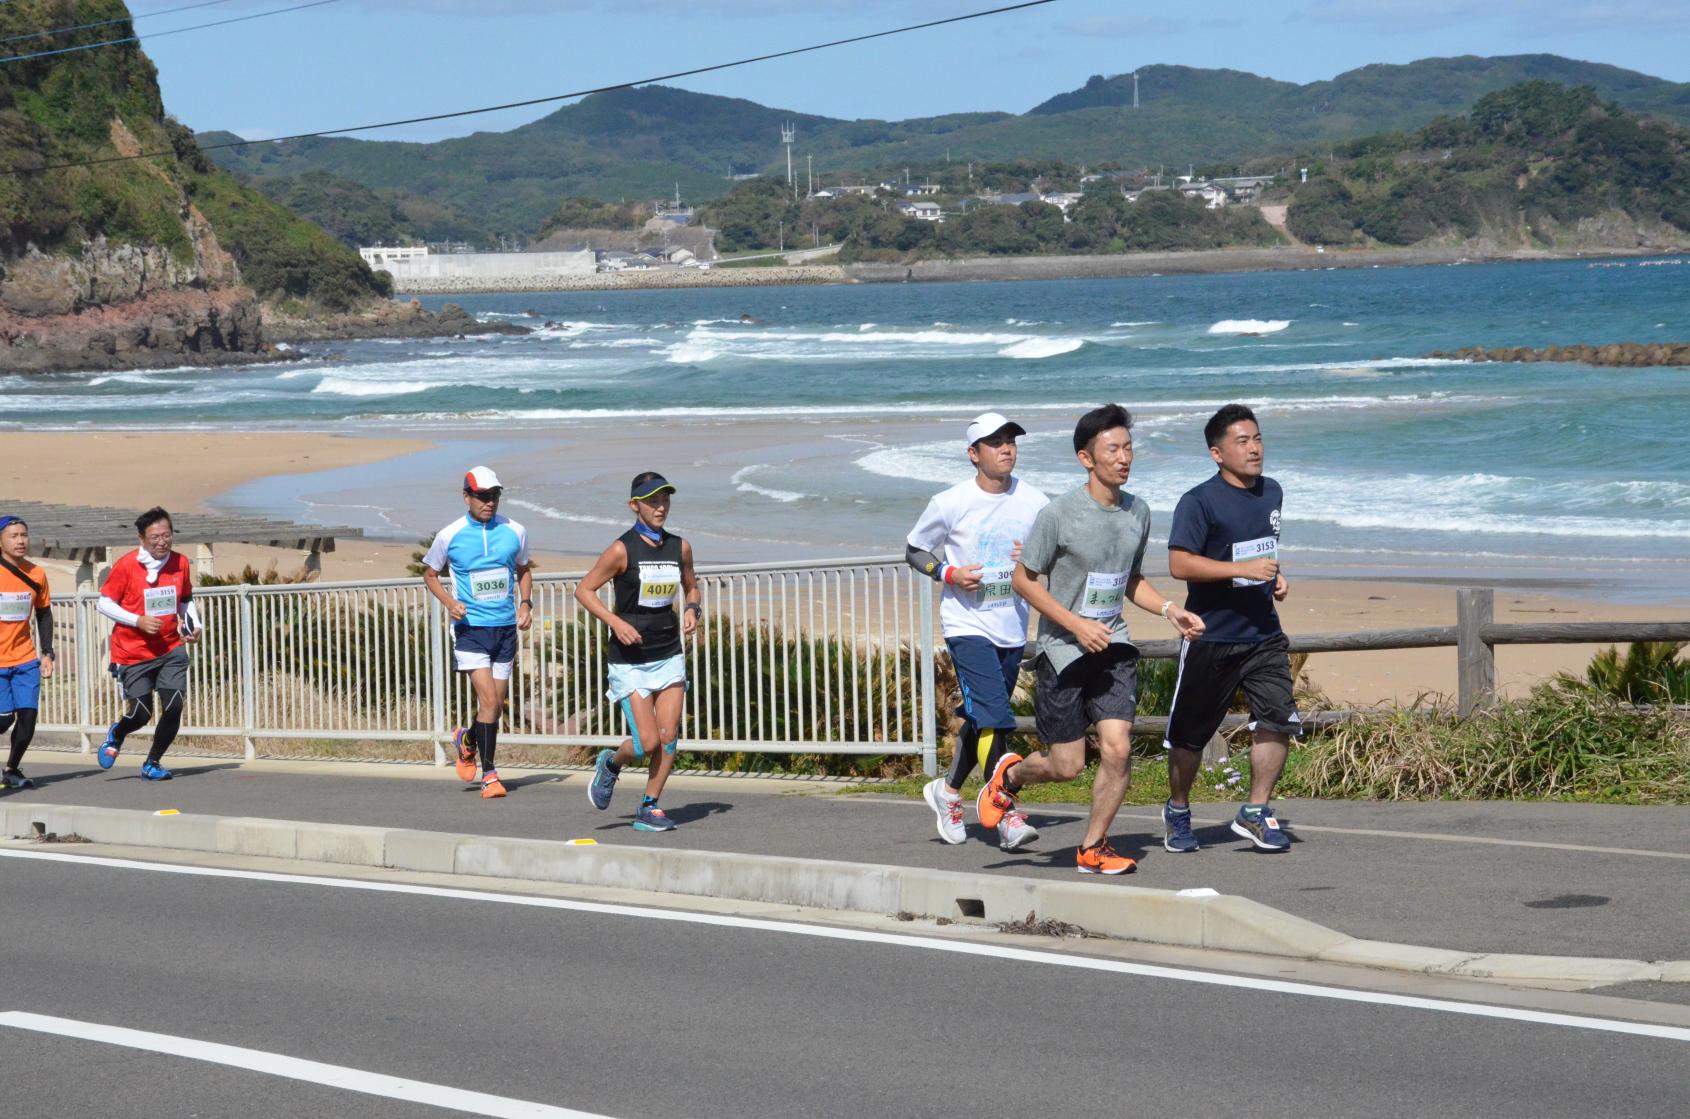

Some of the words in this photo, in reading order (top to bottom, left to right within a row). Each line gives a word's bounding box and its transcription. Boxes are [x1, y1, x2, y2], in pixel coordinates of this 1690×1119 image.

[1256, 540, 1275, 553] 3153
[997, 570, 1014, 580] 309
[476, 580, 505, 592] 3036
[647, 584, 675, 595] 4017
[160, 588, 175, 596] 3159
